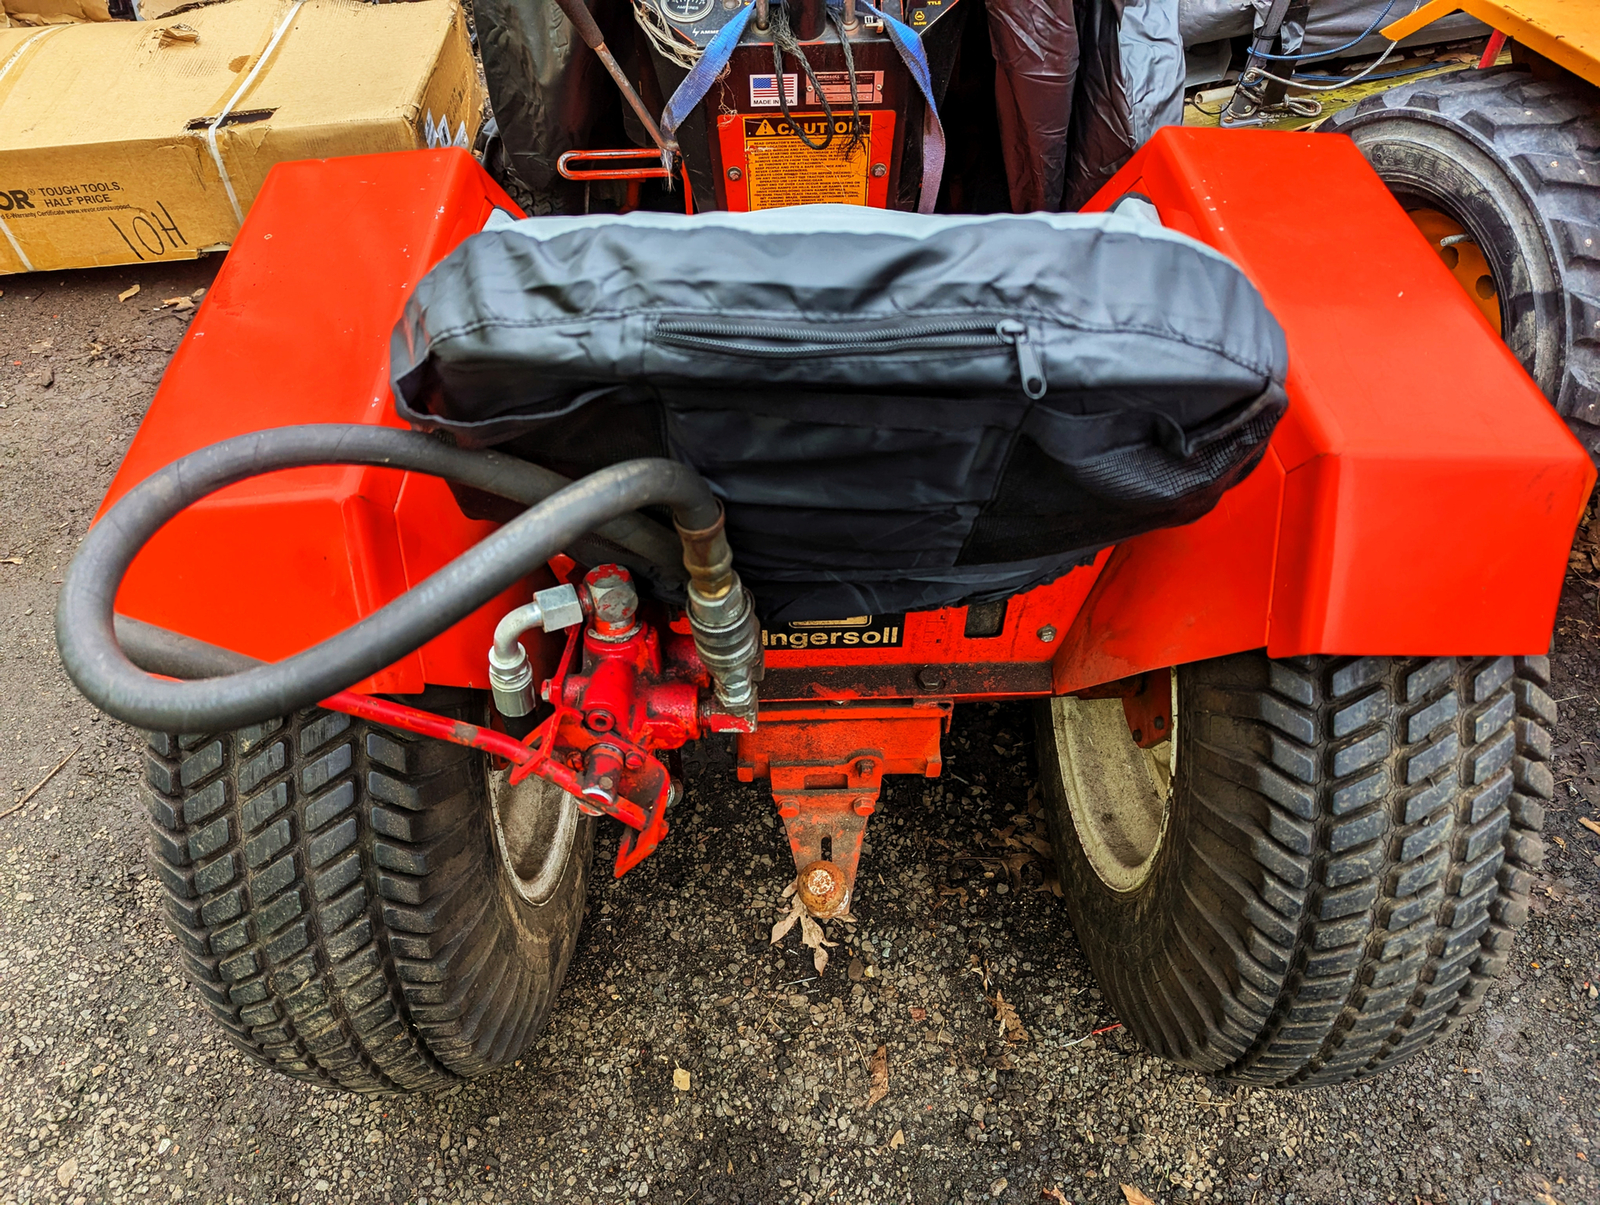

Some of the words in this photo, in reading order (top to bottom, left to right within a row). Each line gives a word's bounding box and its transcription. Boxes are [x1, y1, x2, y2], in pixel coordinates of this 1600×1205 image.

[777, 121, 856, 135] CUTO
[38, 185, 80, 197] TOUGH
[80, 181, 124, 193] TOOLS,
[43, 197, 74, 208] HALF
[76, 193, 112, 205] PRICE
[37, 209, 66, 217] Certificate
[761, 627, 899, 649] Ingersoll
